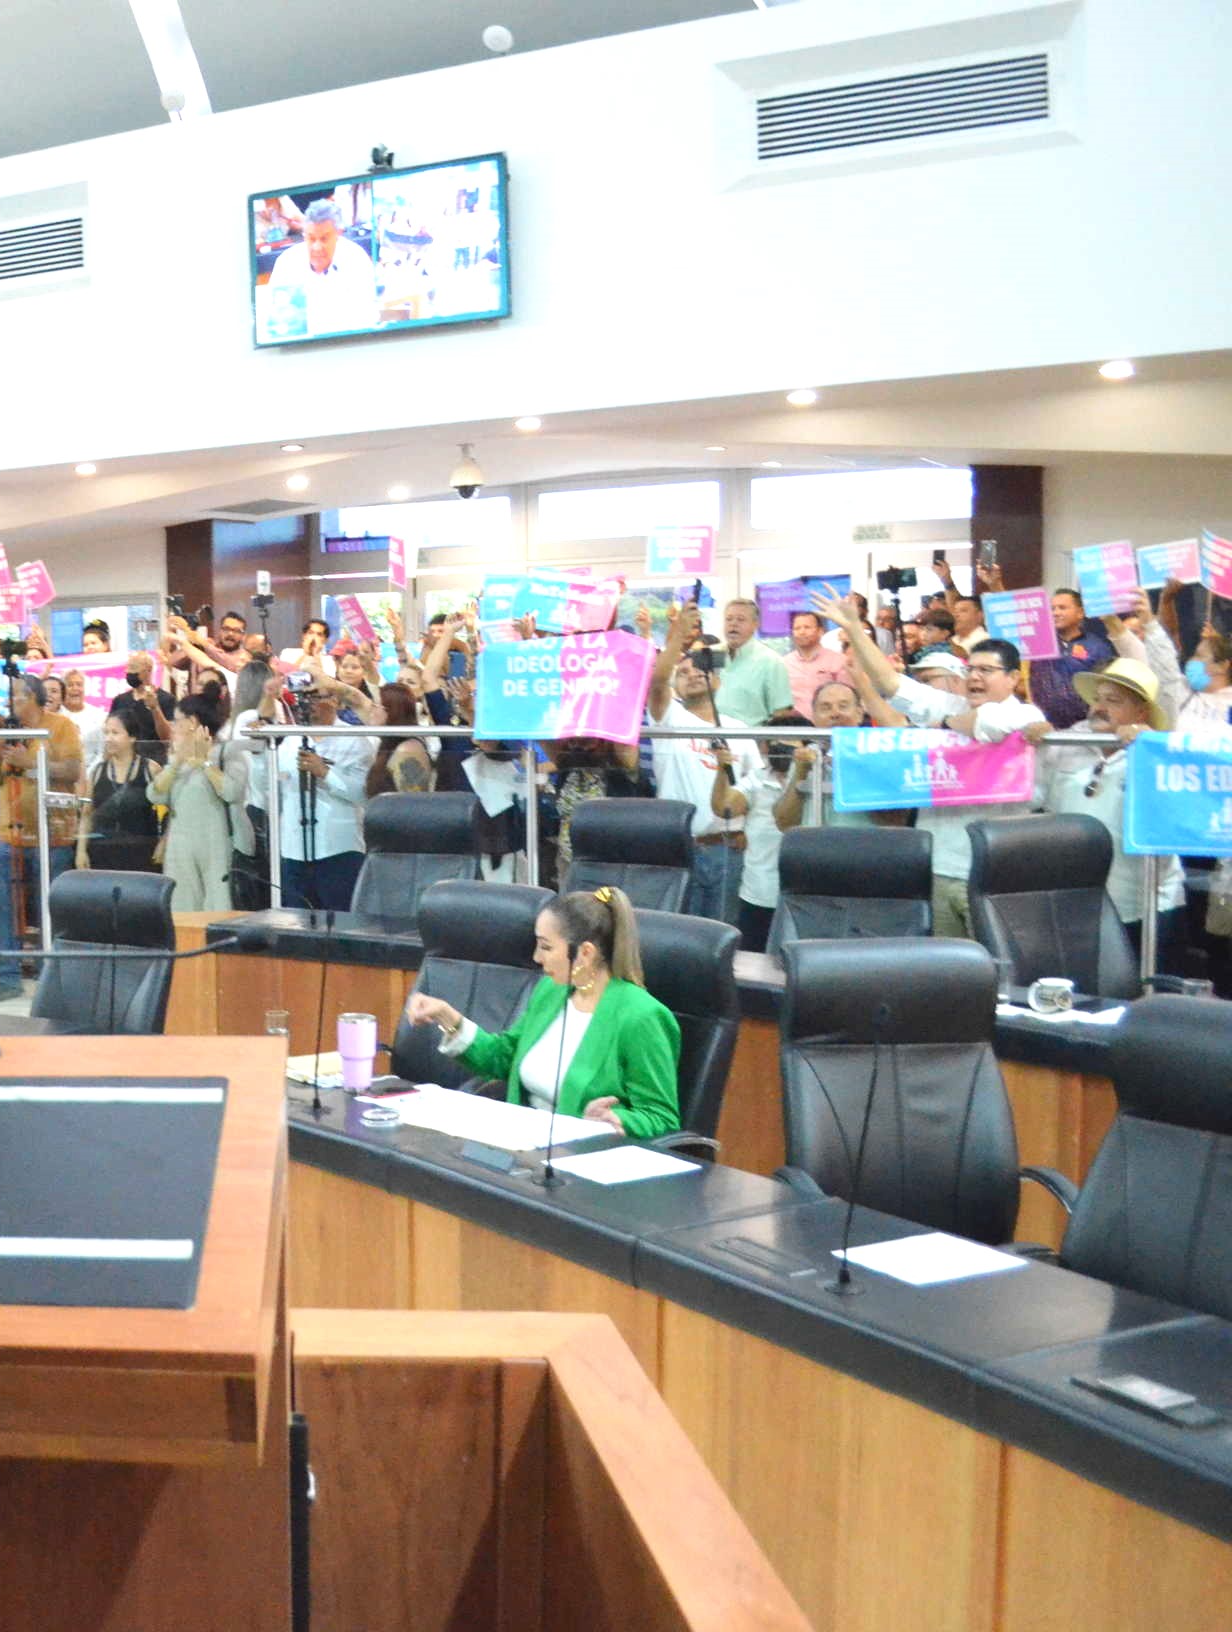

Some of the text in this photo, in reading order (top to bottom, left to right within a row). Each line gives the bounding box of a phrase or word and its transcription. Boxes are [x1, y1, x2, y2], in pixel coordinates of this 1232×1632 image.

[583, 633, 608, 649] LA
[502, 678, 529, 697] DE
[1156, 764, 1201, 792] LOS
